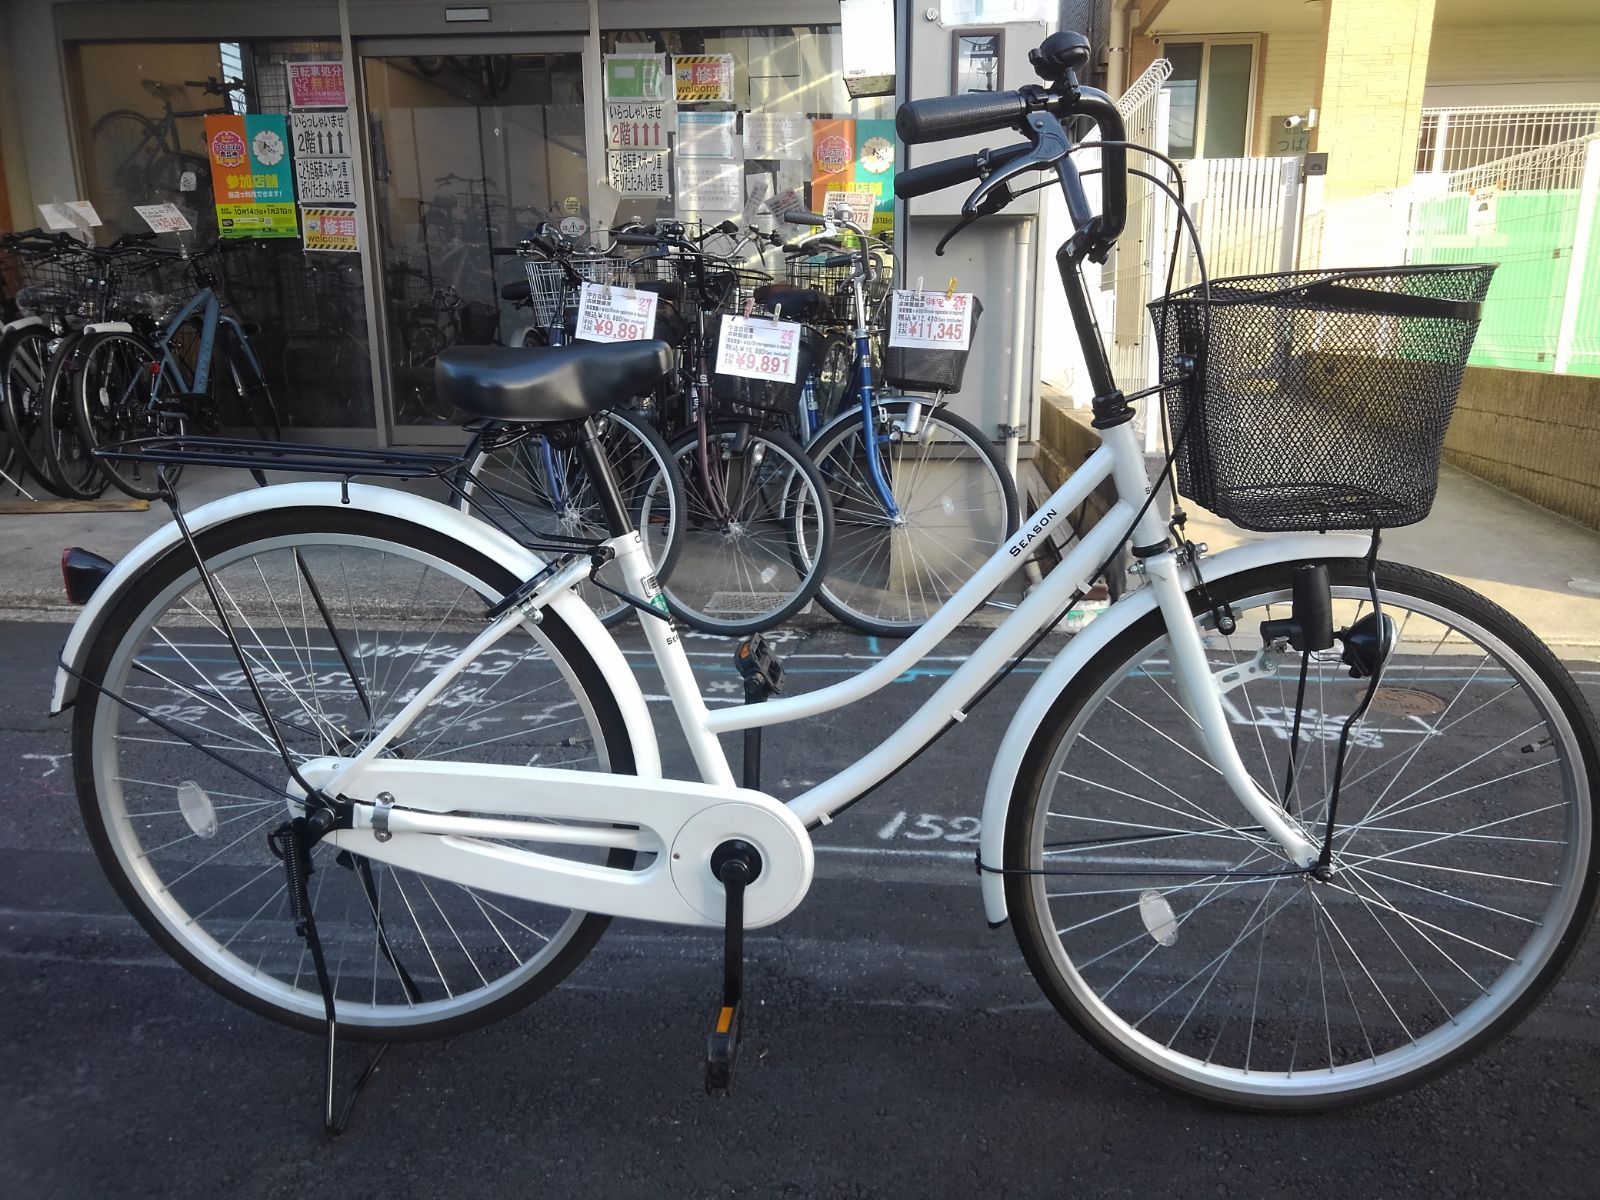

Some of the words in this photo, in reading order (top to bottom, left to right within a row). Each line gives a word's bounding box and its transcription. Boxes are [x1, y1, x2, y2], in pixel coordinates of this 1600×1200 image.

[291, 66, 342, 78] 自転車処分
[696, 65, 730, 84] 修理
[677, 84, 720, 93] welcome
[293, 114, 344, 129] いらっしゃいませ
[609, 105, 662, 119] いらっしゃいませ
[297, 130, 316, 154] 2階
[612, 121, 631, 145] 2階
[225, 174, 279, 189] 参加店舗
[324, 218, 356, 236] 修理
[594, 319, 646, 340] ¥9,891
[908, 321, 963, 341] ¥11,345
[735, 352, 789, 374] ¥9,891
[1009, 508, 1057, 557] SEASON
[877, 811, 981, 843] 152
